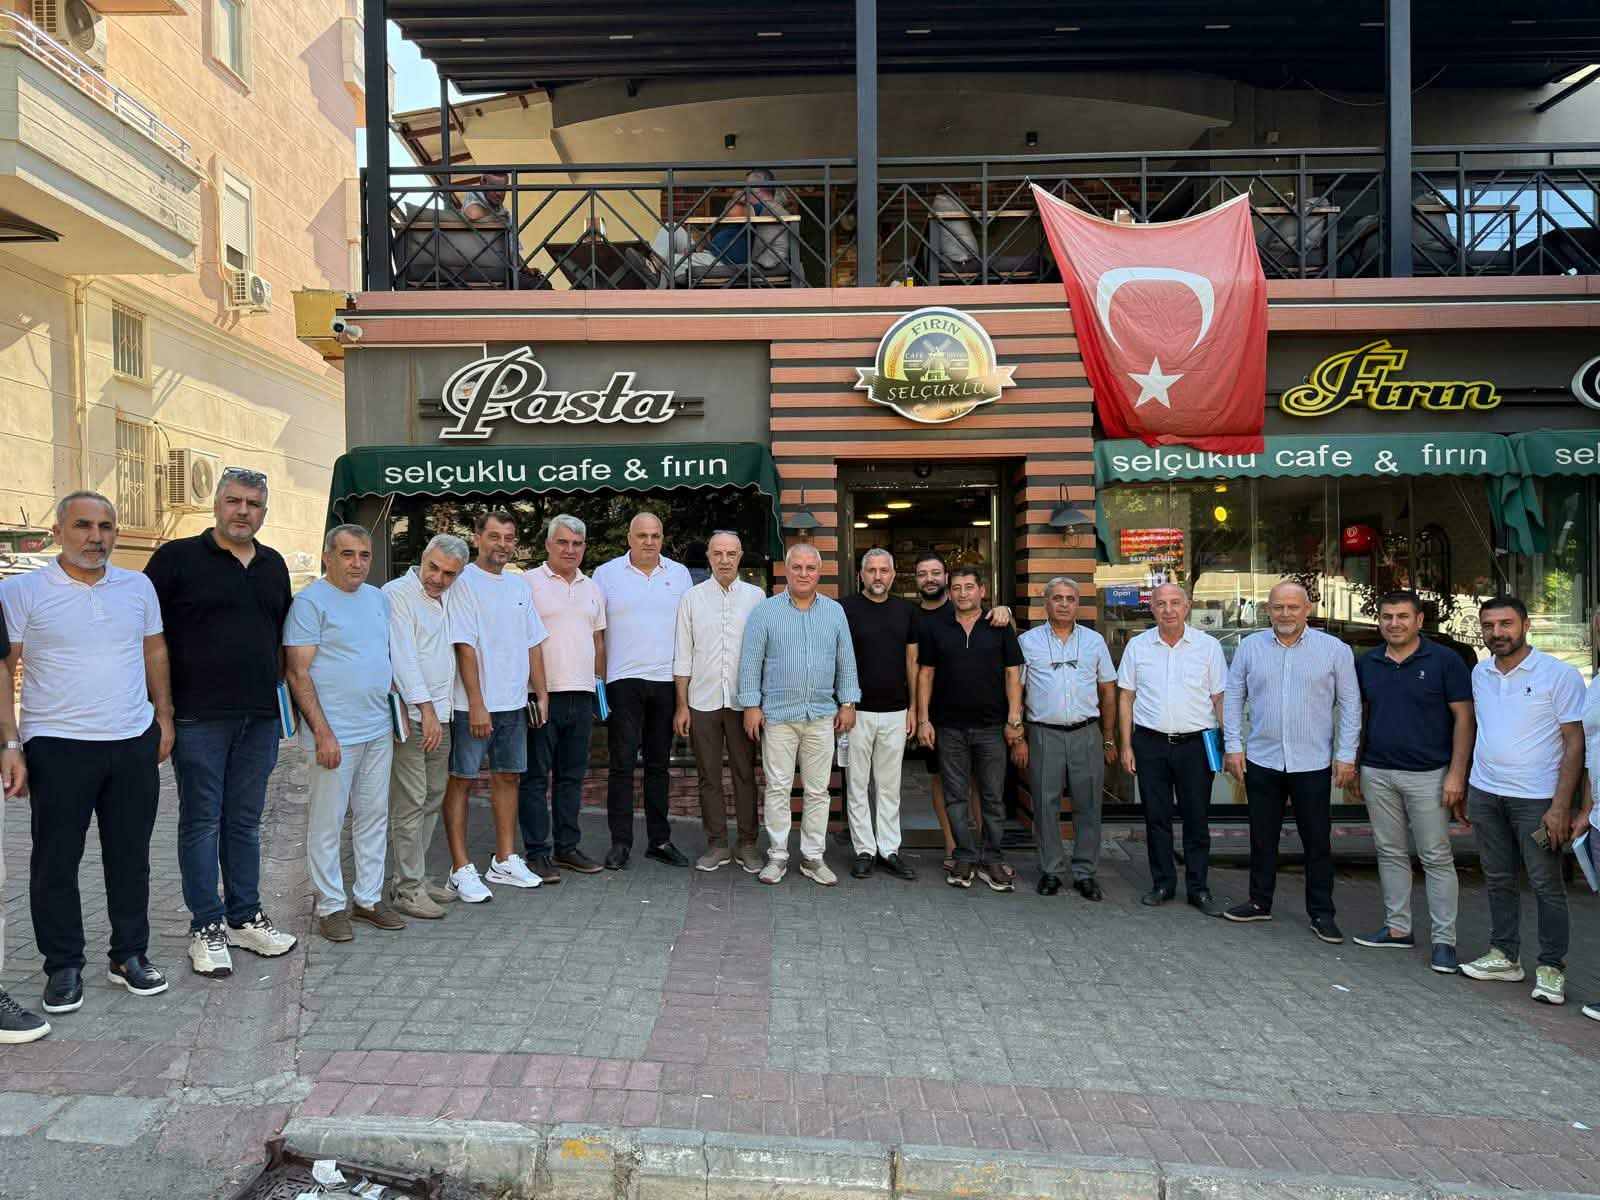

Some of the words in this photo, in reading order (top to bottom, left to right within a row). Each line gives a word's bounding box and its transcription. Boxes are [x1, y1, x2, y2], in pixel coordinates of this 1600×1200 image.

[911, 318, 961, 337] FIRIN
[438, 345, 675, 438] Pasta
[887, 382, 987, 401] SELÇUKLU
[384, 459, 527, 489] selçuklu
[538, 458, 612, 482] cafe
[623, 458, 649, 481] &
[660, 455, 728, 477] fırın
[1275, 444, 1353, 467] cafe
[1374, 450, 1400, 473] &
[1421, 443, 1487, 465] fırın
